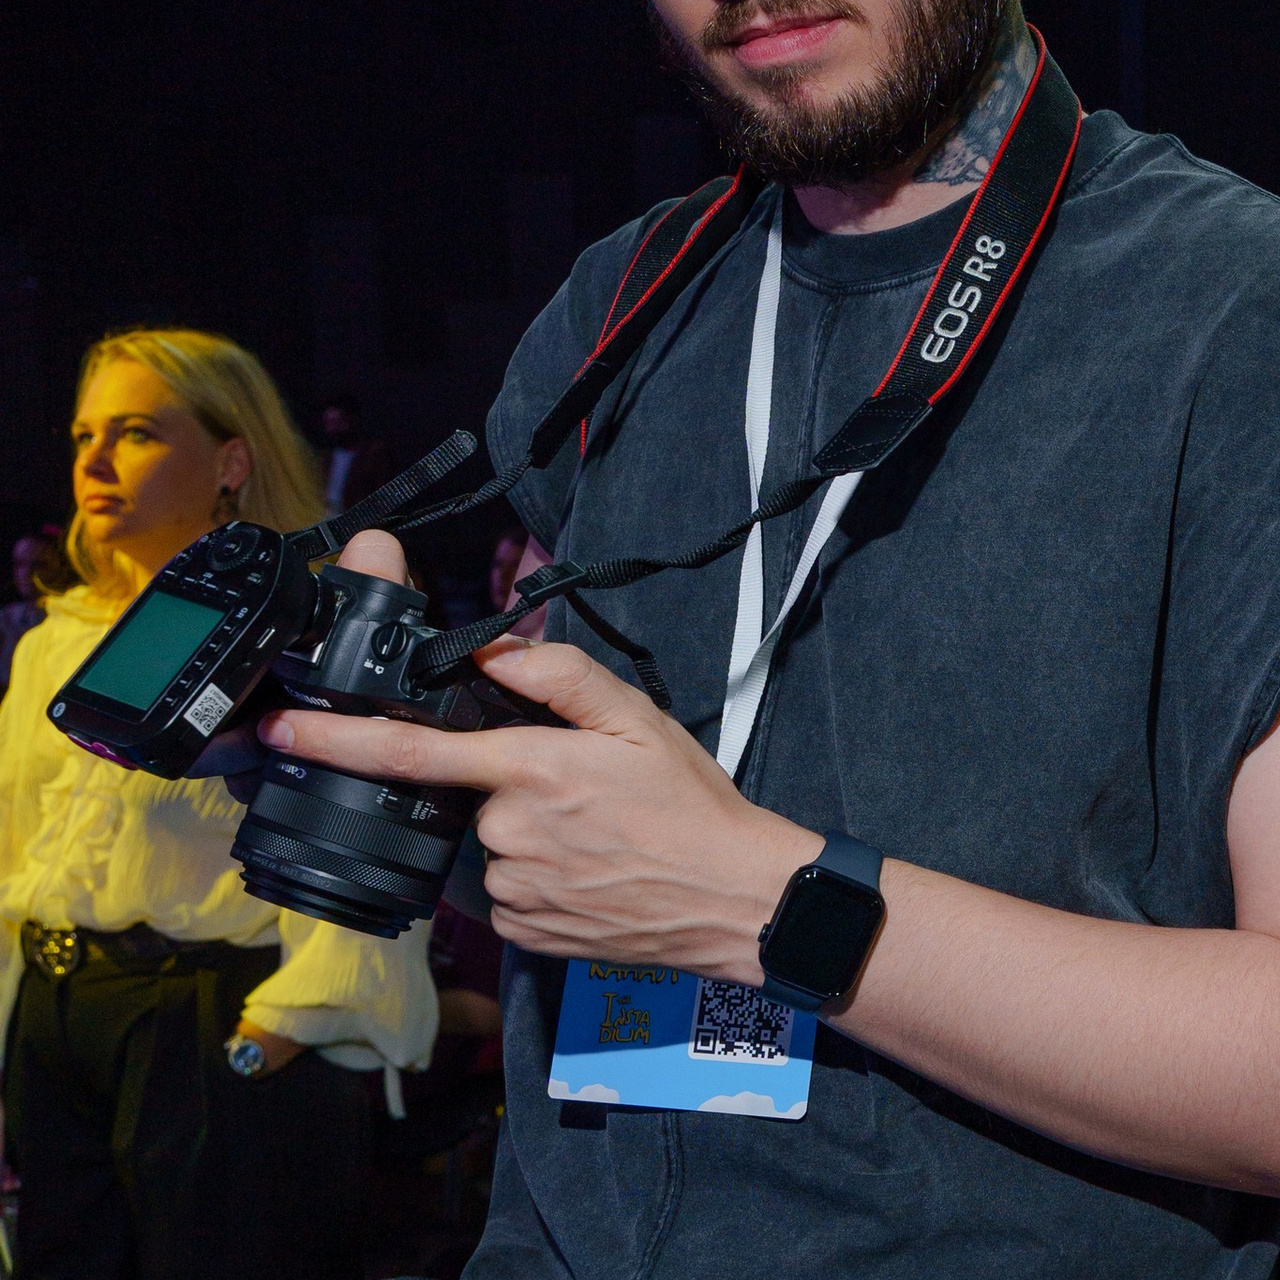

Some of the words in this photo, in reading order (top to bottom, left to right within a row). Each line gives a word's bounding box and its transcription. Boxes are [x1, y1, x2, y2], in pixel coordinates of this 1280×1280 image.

[920, 281, 982, 363] EOS
[962, 235, 1006, 282] R8
[284, 684, 332, 708] Canon
[280, 864, 299, 877] LENS
[302, 873, 331, 888] CANON
[599, 1026, 651, 1045] DIUM
